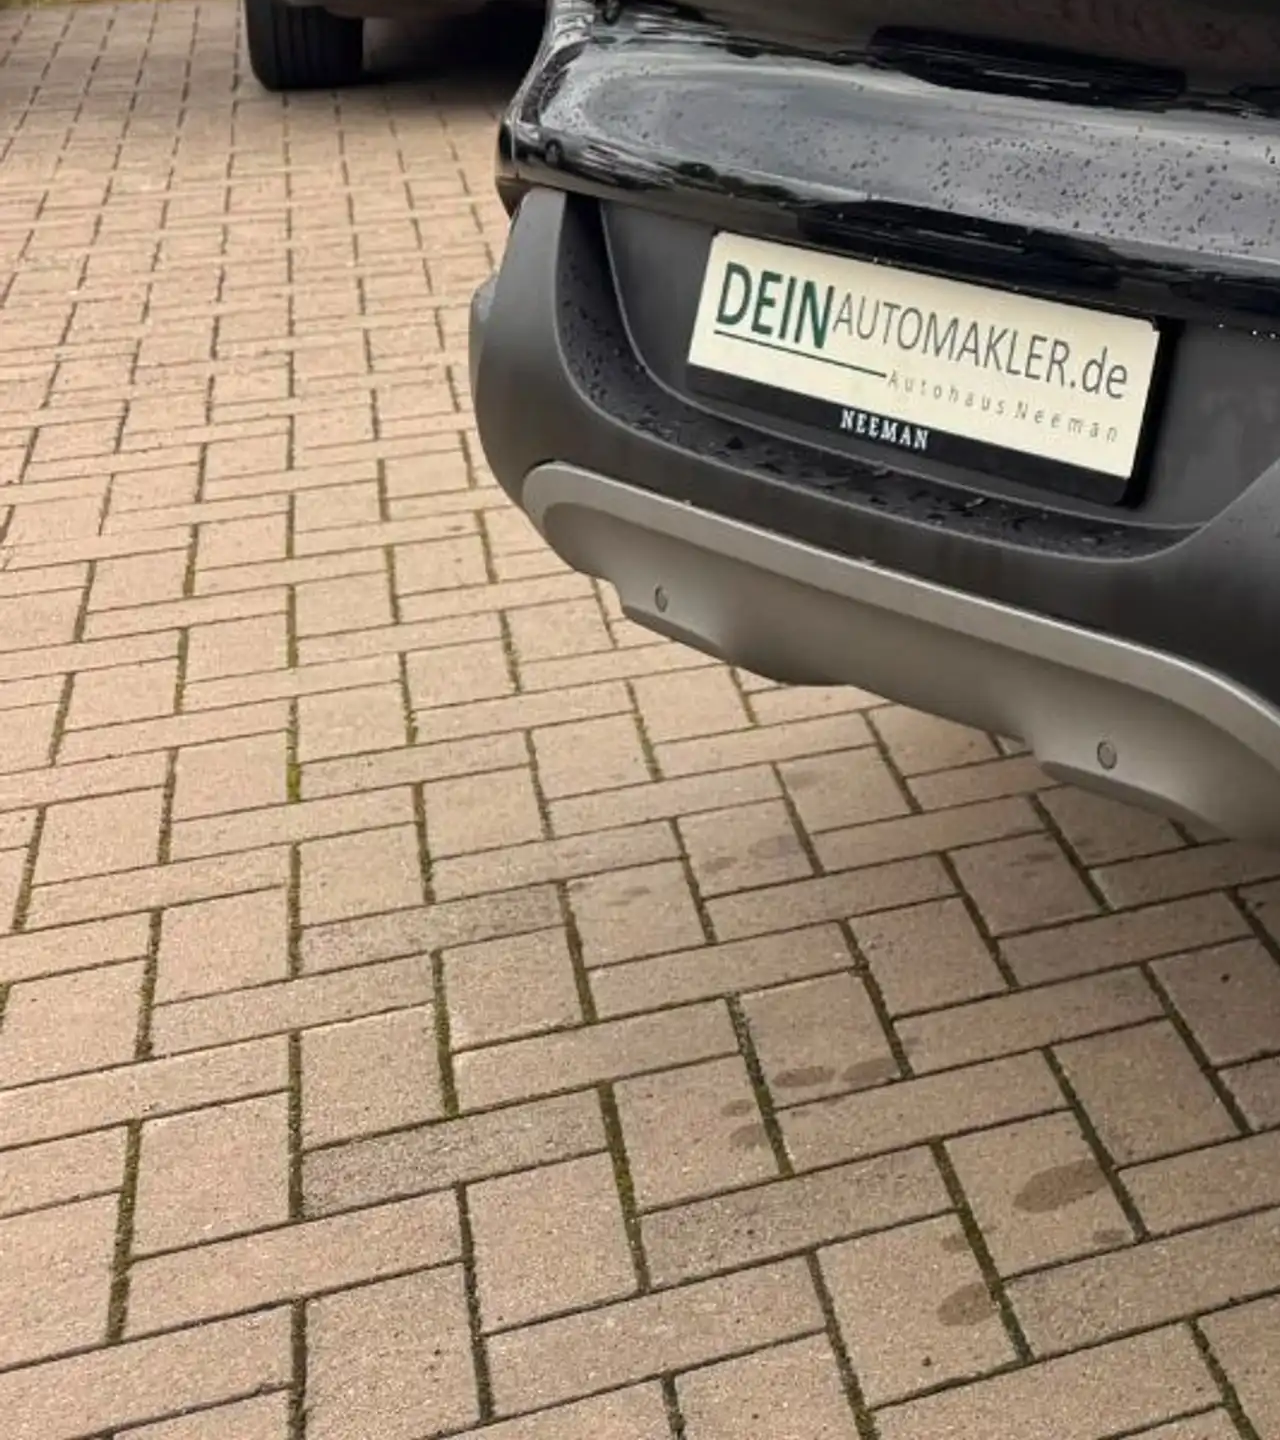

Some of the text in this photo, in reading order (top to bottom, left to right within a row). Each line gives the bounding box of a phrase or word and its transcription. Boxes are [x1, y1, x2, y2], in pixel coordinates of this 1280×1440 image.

[716, 261, 1128, 399] DEINAUTOMAKLER.de
[839, 408, 931, 451] NEEMAN
[887, 369, 1119, 443] Autohaus Neeman
